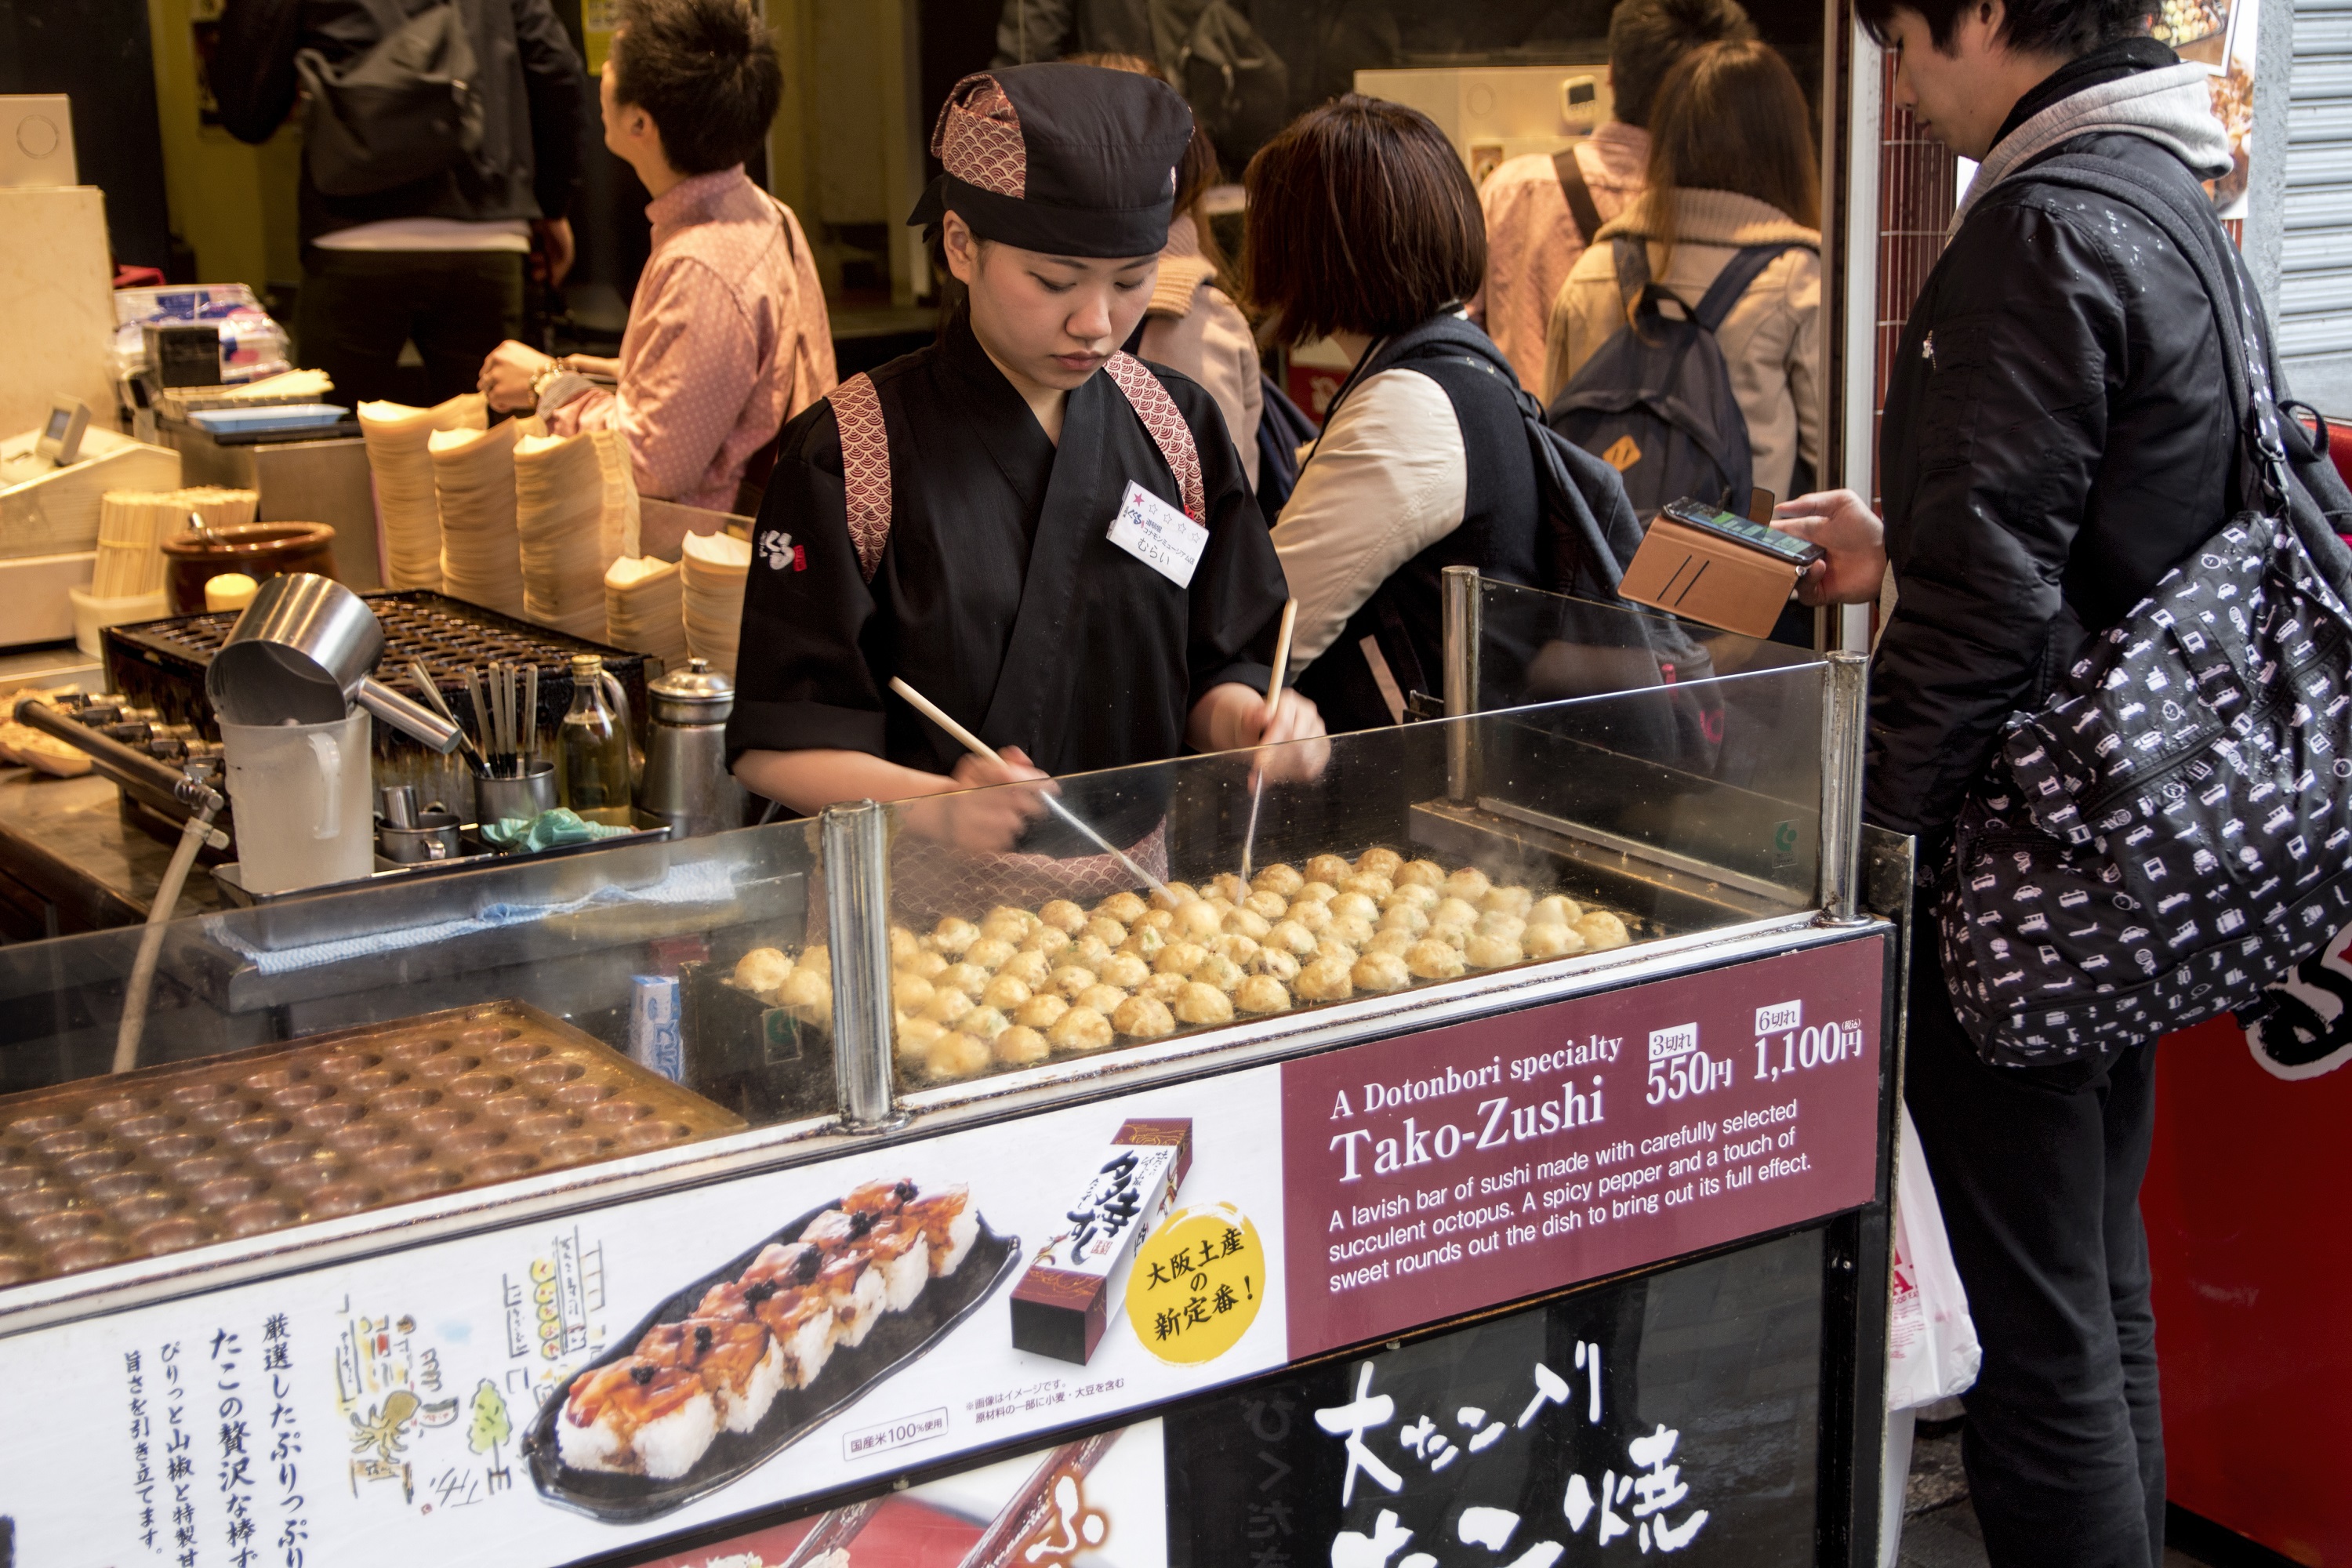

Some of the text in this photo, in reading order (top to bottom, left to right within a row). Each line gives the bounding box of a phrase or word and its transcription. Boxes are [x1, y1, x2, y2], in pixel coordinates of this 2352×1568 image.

[1138, 537, 1170, 564] むらい
[1653, 1033, 1692, 1056] 3切れ
[1759, 1008, 1796, 1031] 6切れ
[1330, 1034, 1623, 1119] A Dotonbori specialty
[1646, 1051, 1733, 1105] 550円
[1754, 1022, 1862, 1081] 1,100円
[1329, 1075, 1604, 1182] Tako-Zushi
[1329, 1098, 1797, 1232] A lavish bar of sushi made with carefully selected
[1329, 1126, 1796, 1261] succulent octopus. A spicy pepper and a touch of
[1330, 1152, 1811, 1291] sweet rounds out the dish to bring out its full effect.
[1146, 1227, 1245, 1291] 大阪土産
[1190, 1272, 1207, 1292] の
[975, 1377, 1126, 1425] 原材料の一部に小麦・大豆を含む
[124, 1349, 162, 1555] 旨さを引き立てます。
